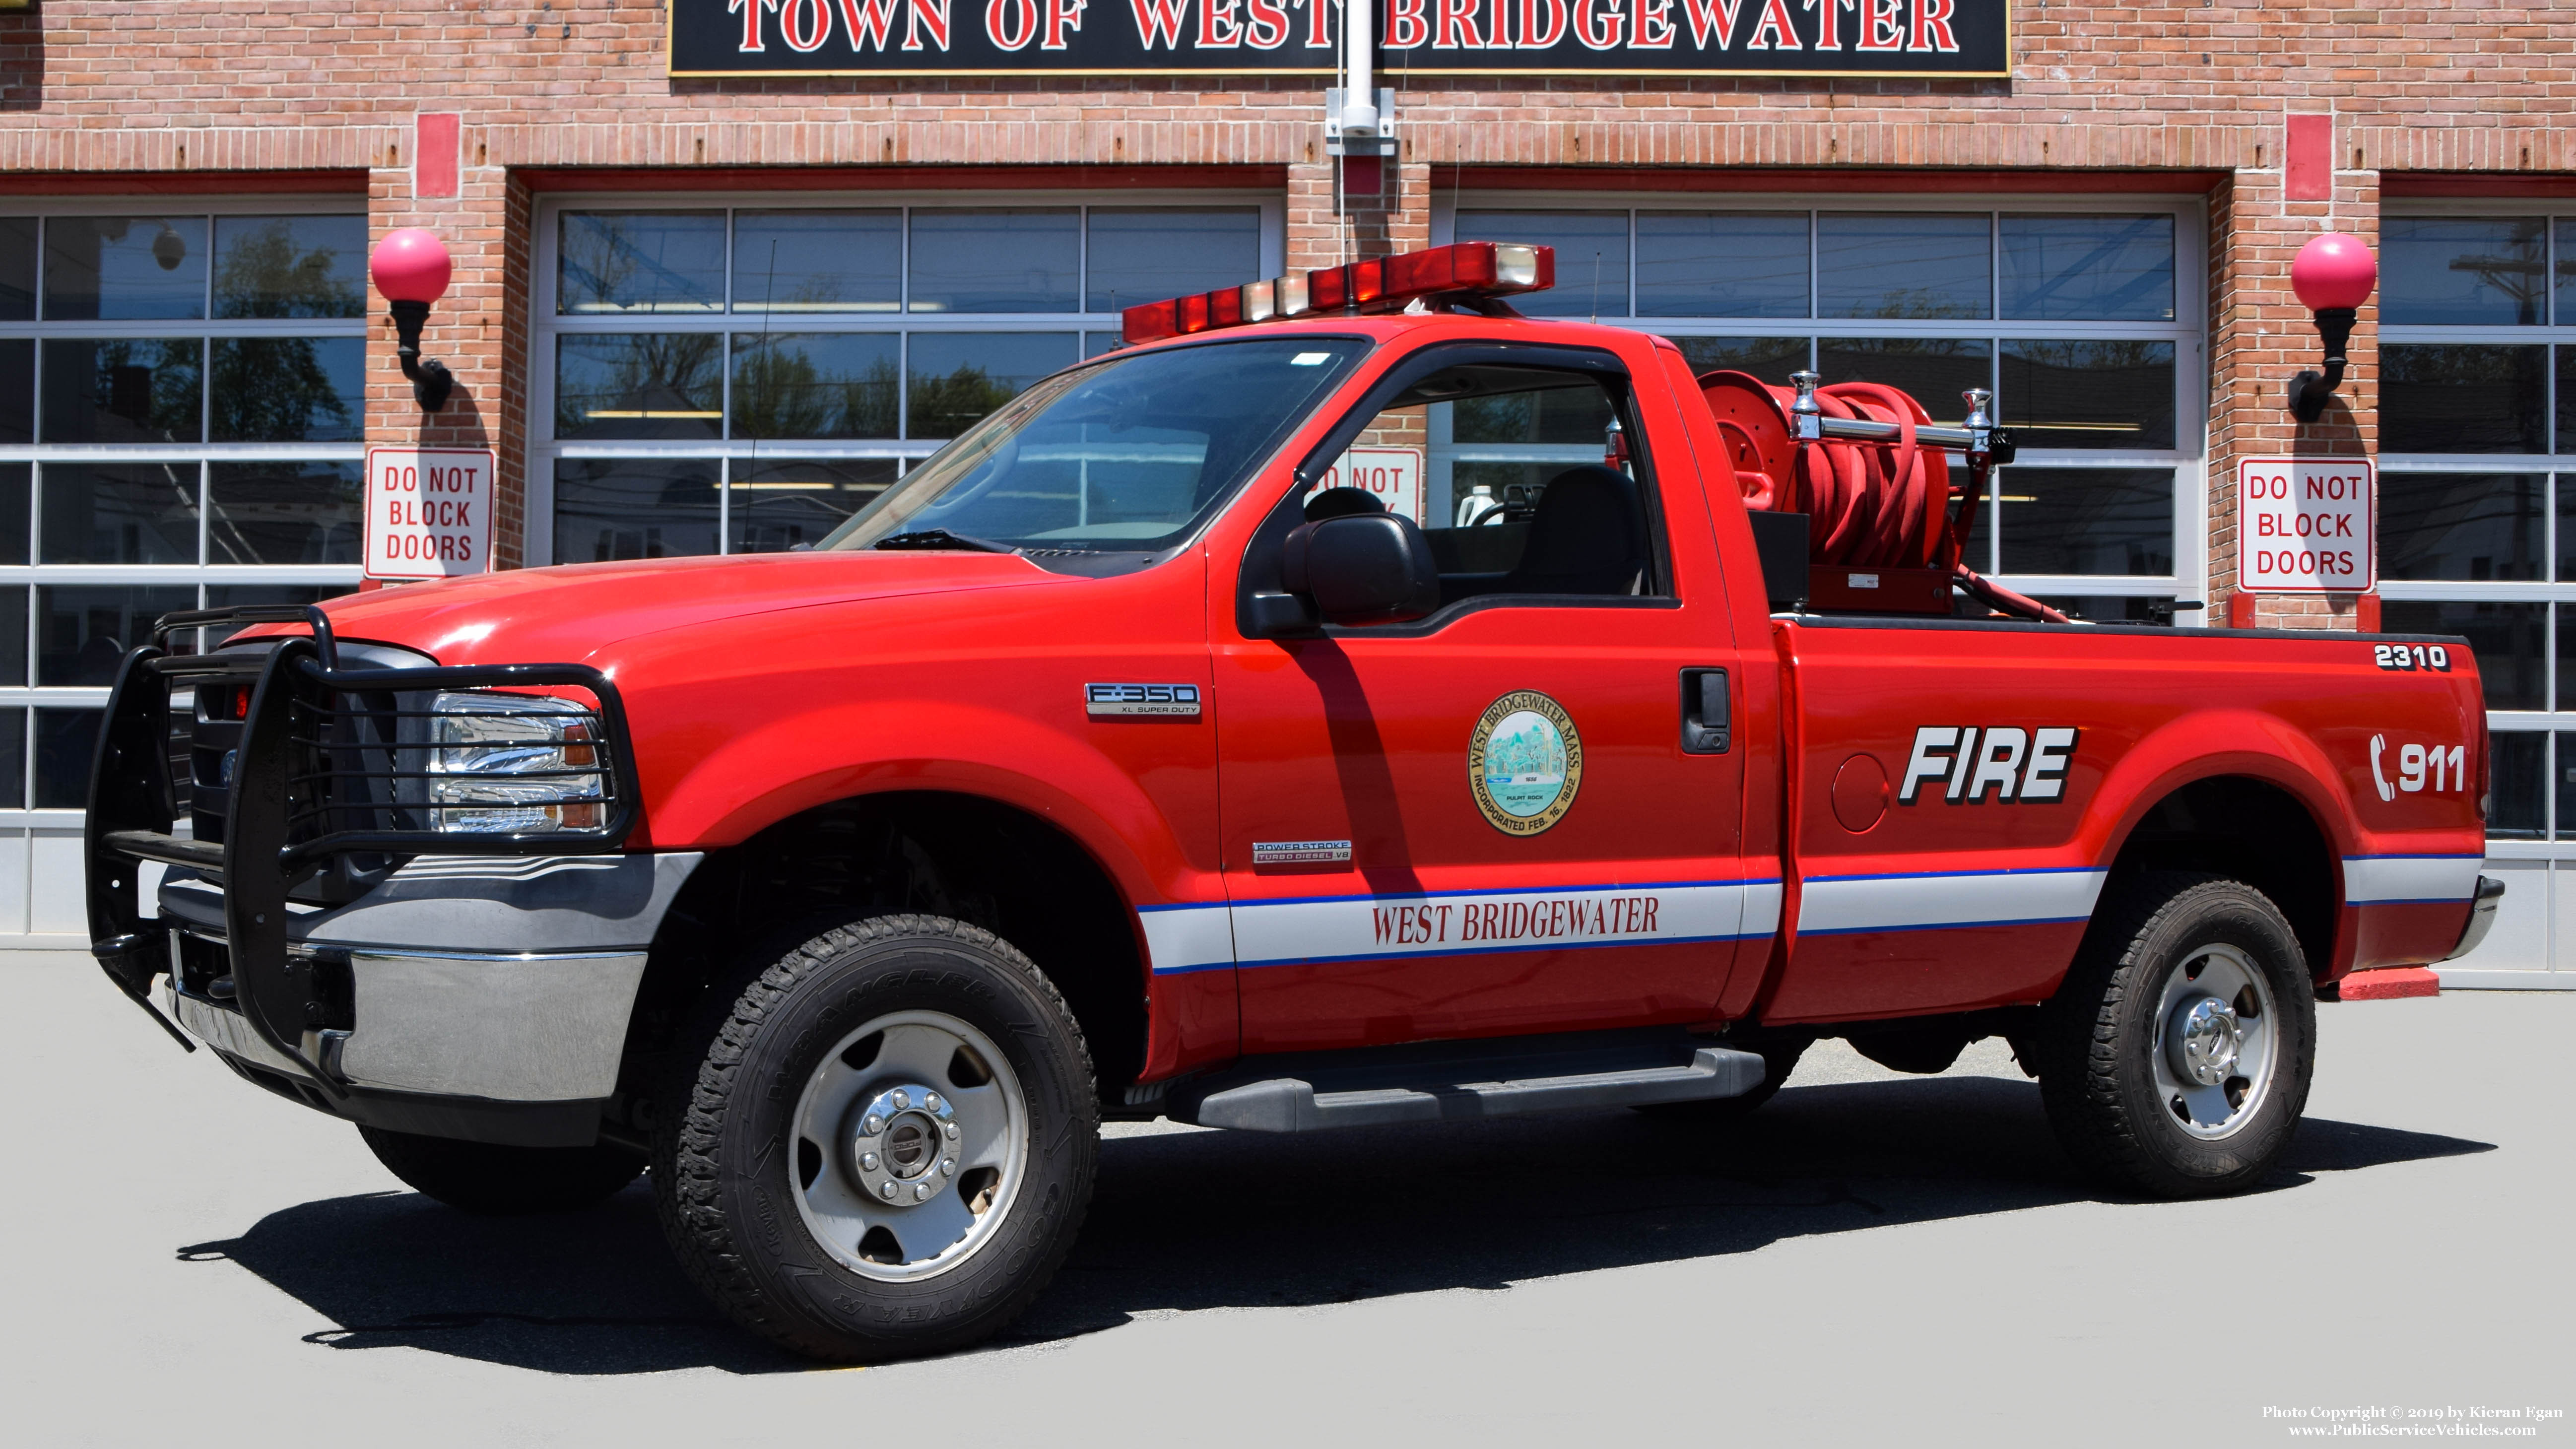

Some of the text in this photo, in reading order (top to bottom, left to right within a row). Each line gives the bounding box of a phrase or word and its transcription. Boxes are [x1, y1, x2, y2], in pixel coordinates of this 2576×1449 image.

[728, 0, 1960, 52] TOWN OF WEST BRIDGEWATER
[385, 466, 477, 493] DO NOT
[1310, 466, 1403, 493] O NOT
[2250, 476, 2362, 500] DO NOT
[390, 501, 470, 526] BLOCK
[2258, 513, 2353, 537] BLOCK
[387, 534, 471, 561] DOORS
[2257, 550, 2354, 575] DOORS
[2375, 645, 2449, 670] 2310
[1089, 686, 1197, 703] F-350
[1471, 725, 1489, 769] WEST
[1485, 694, 1567, 727] BRIDGEWATER
[1897, 725, 2080, 805] FIRE
[2399, 744, 2464, 791] 911
[1474, 774, 1525, 831] INCORPORATED
[1561, 778, 1576, 803] 1822
[1373, 897, 1659, 945] WEST BRIDGEWATER
[894, 1140, 921, 1149] FORD
[832, 1182, 1059, 1322] GOODYEAR
